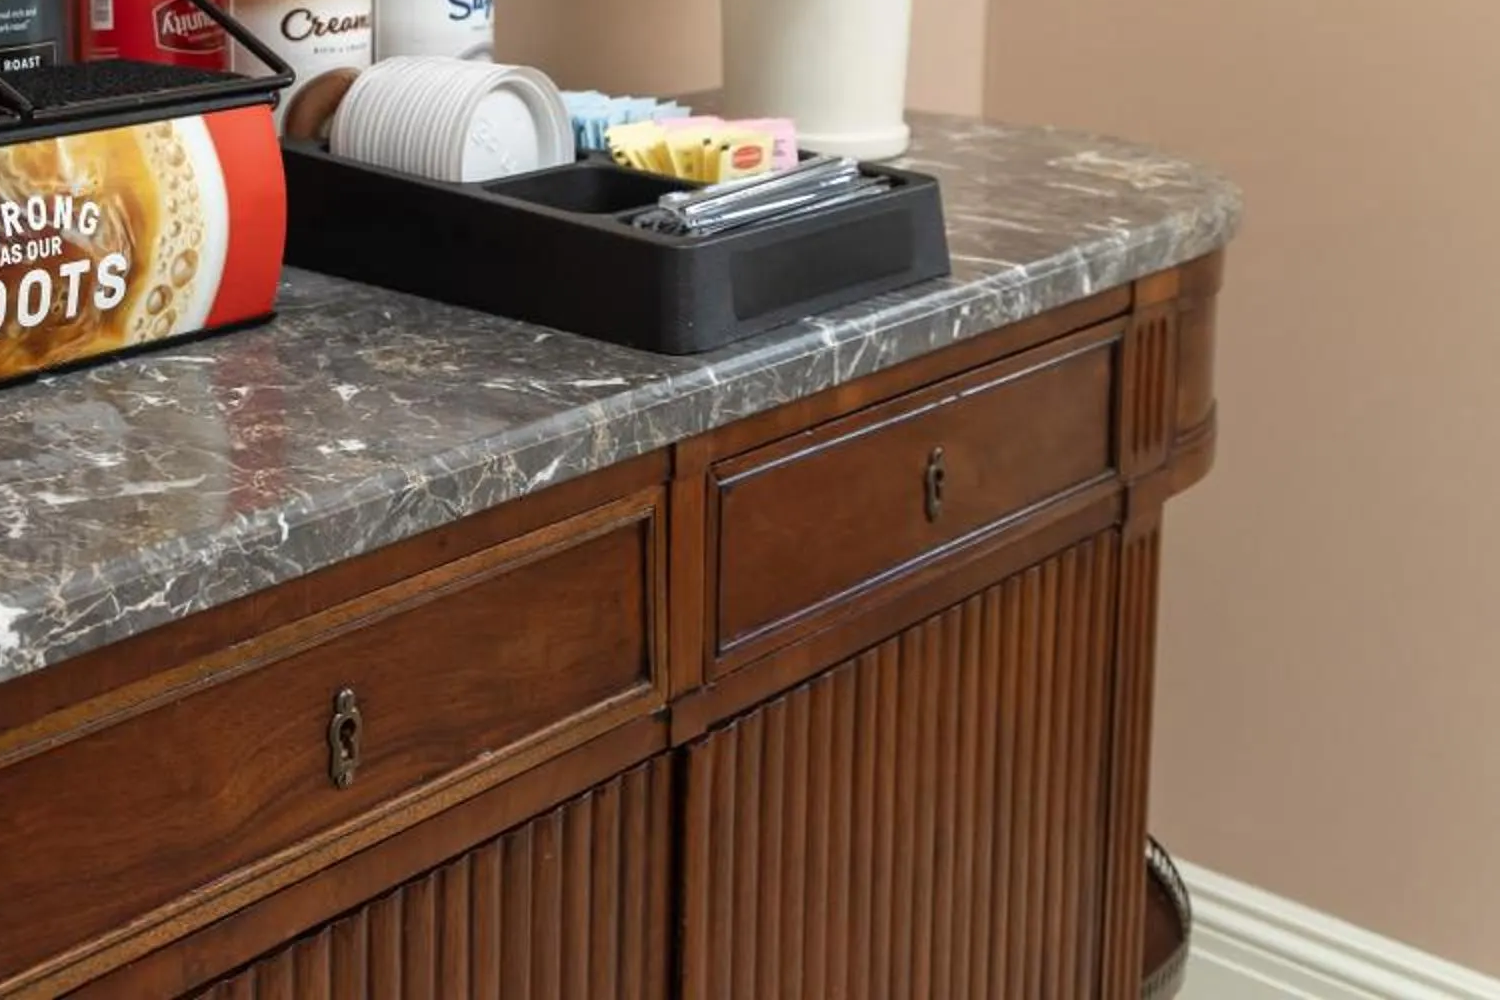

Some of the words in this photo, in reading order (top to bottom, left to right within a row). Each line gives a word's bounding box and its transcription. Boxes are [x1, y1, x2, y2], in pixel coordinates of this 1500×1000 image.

[3, 55, 41, 71] ROAST
[0, 247, 22, 267] AS
[27, 236, 63, 261] OUR
